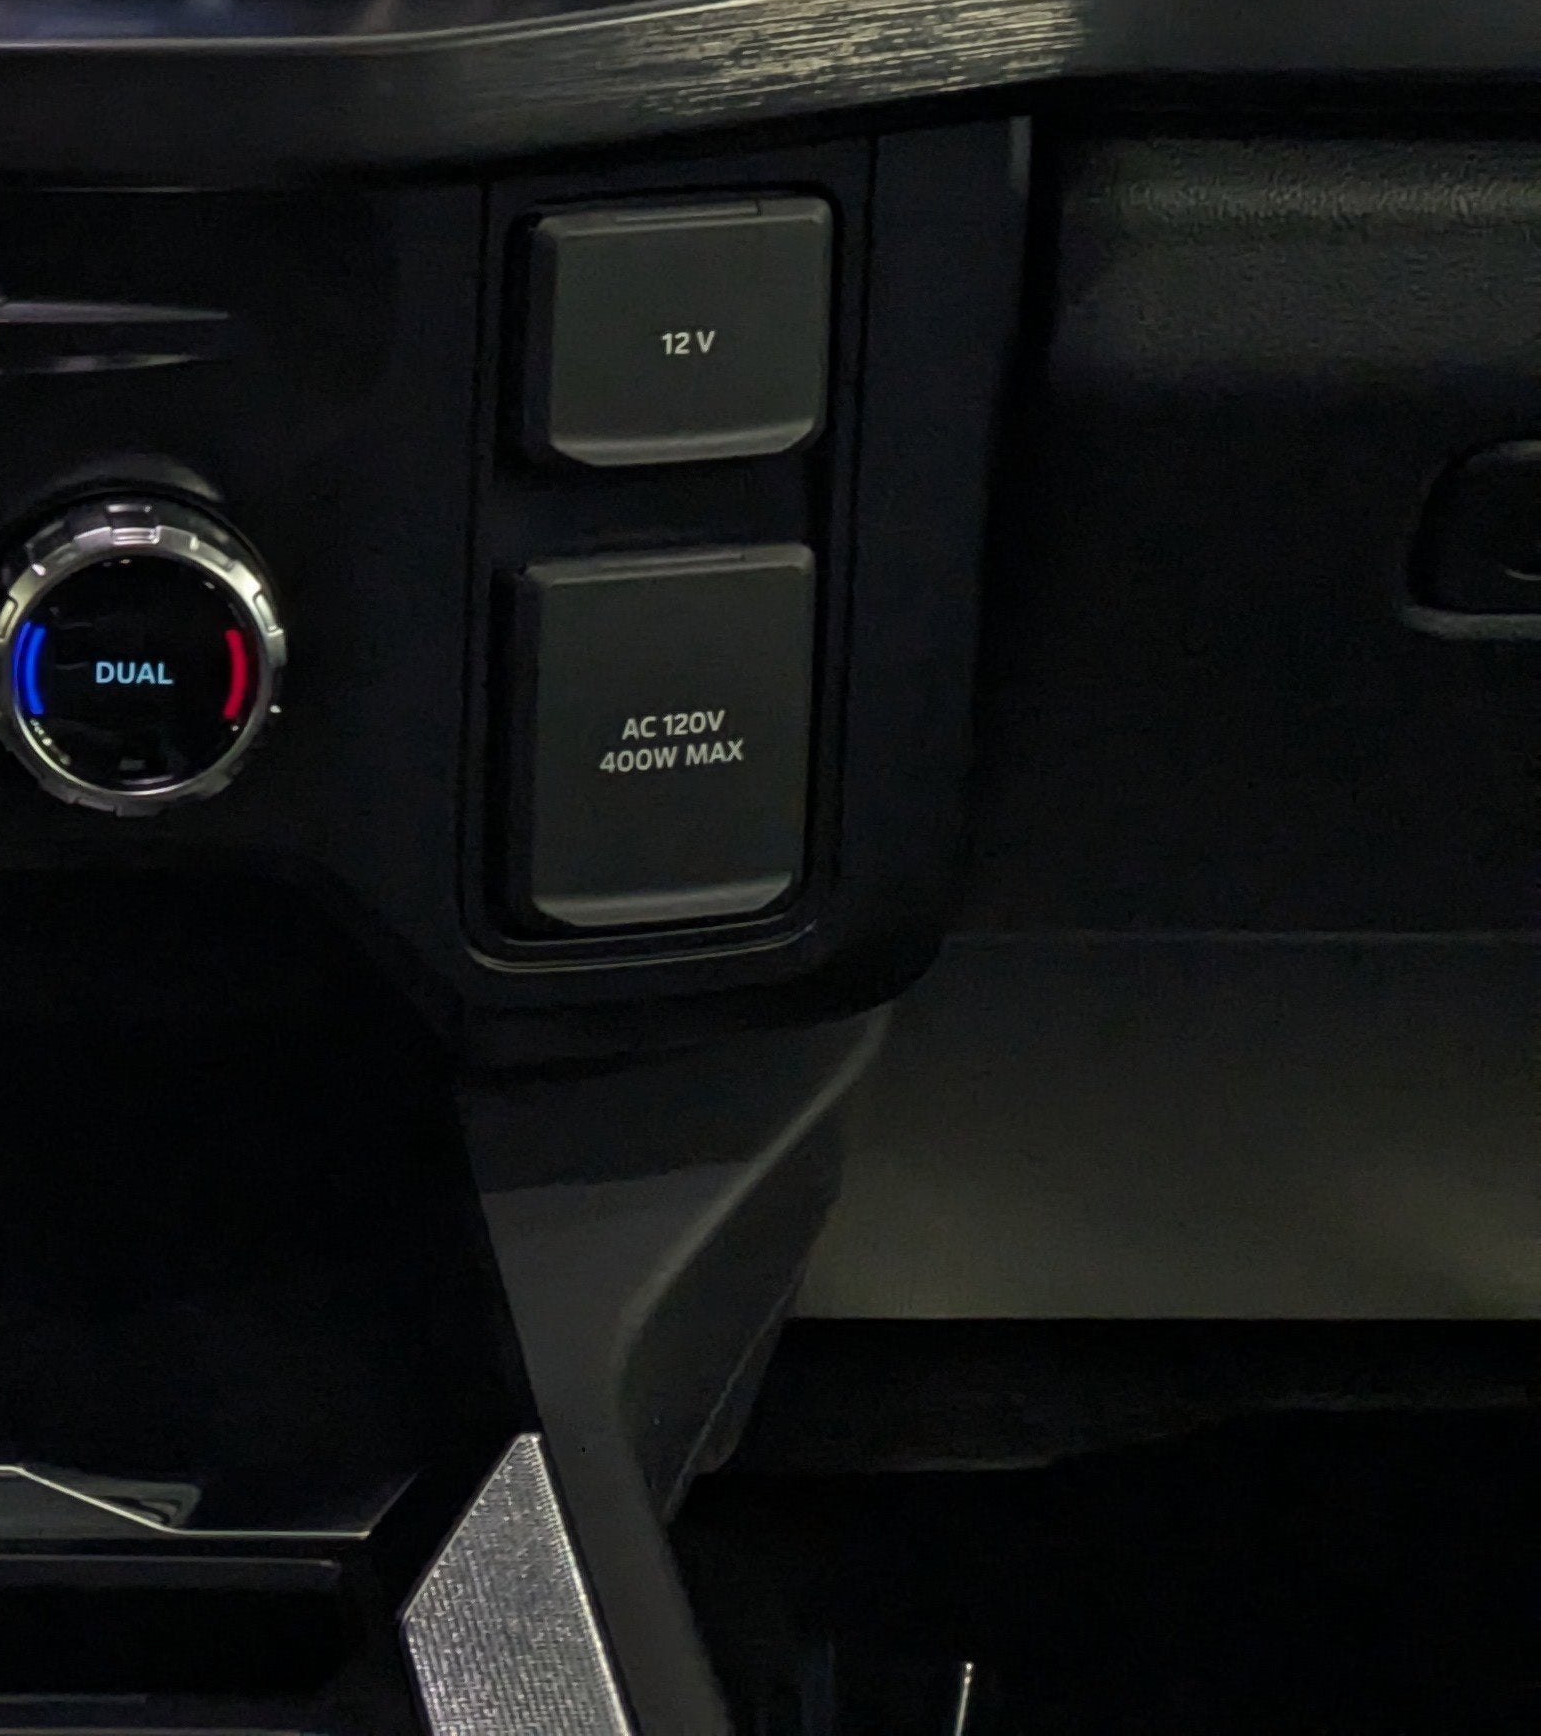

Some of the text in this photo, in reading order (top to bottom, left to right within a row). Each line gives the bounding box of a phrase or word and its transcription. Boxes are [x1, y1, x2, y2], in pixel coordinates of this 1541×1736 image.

[662, 330, 716, 355] 12 V
[95, 660, 174, 685] DUAL
[621, 709, 725, 740] AC 120V
[599, 738, 743, 773] 400W MAX
